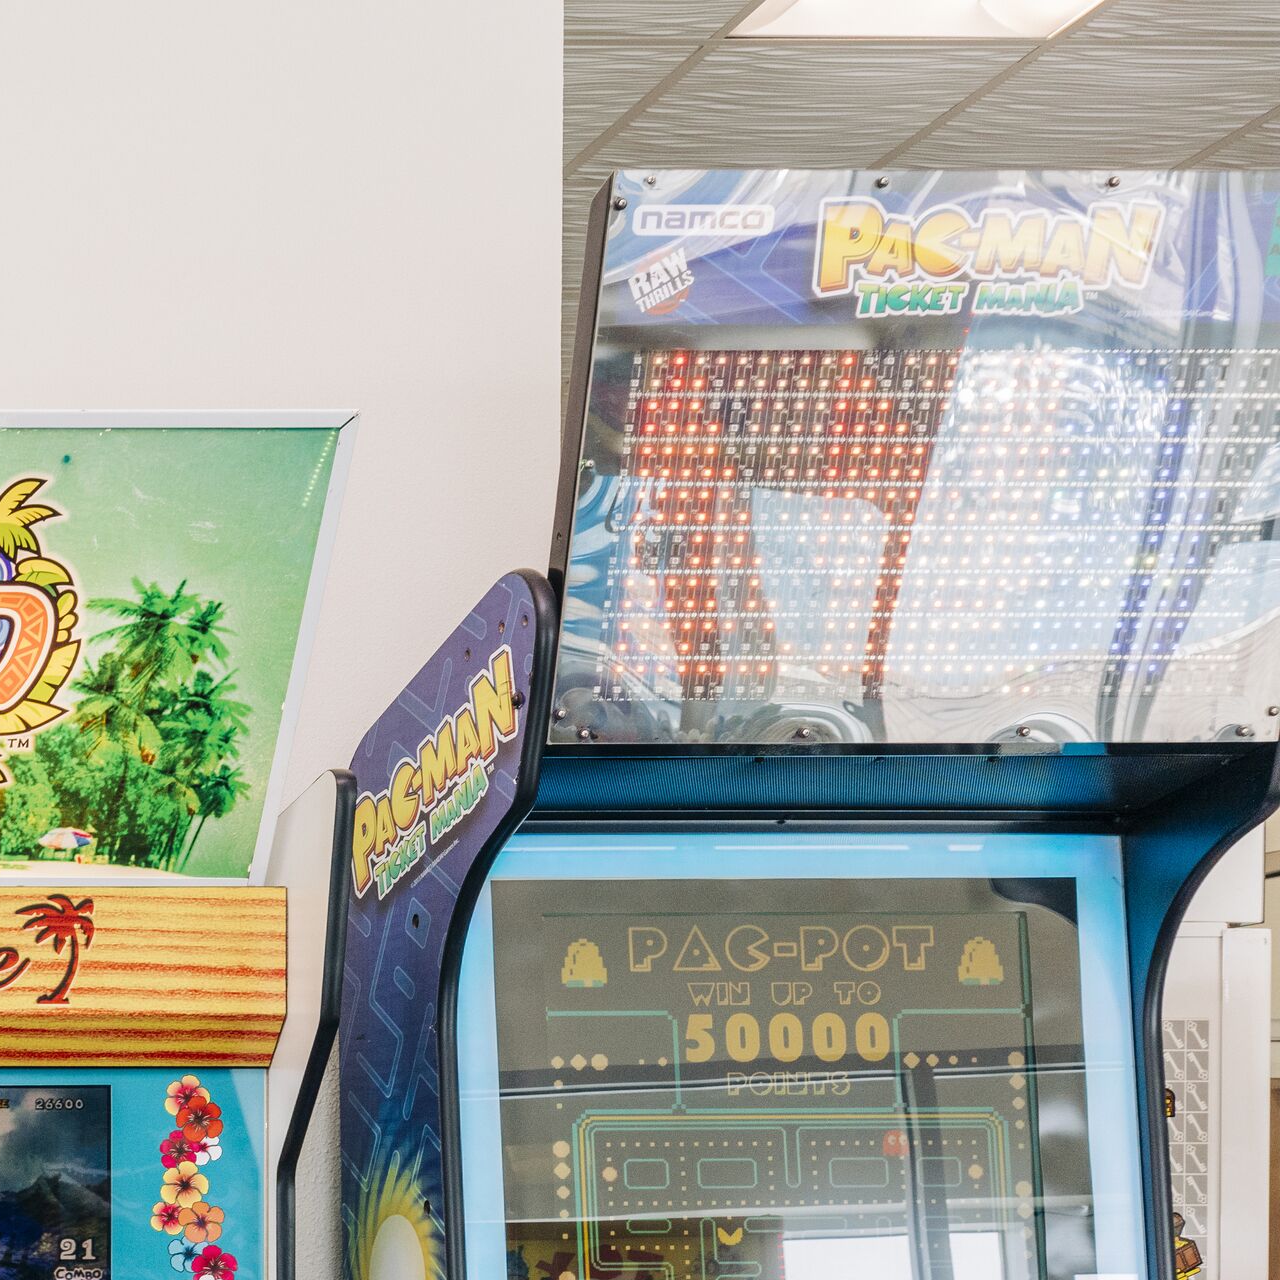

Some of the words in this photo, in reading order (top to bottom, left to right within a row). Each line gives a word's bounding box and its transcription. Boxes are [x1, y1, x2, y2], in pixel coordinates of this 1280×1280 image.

[640, 210, 766, 230] namco
[818, 203, 1162, 292] PAC-MAN
[627, 247, 688, 301] RAW
[635, 269, 695, 313] THRILLS
[857, 283, 965, 318] TICKET
[974, 281, 1085, 316] MANIA
[352, 647, 517, 897] PAC-MAN
[374, 826, 427, 898] TICKET
[431, 763, 488, 844] MANIA
[627, 923, 935, 974] PAC-POT
[686, 981, 751, 1006] WIN
[770, 981, 814, 1005] UP
[834, 980, 882, 1004] TO
[685, 1012, 891, 1063] 50000
[35, 1098, 85, 1110] 26600
[726, 1071, 851, 1097] POINTS
[58, 1237, 97, 1261] 21
